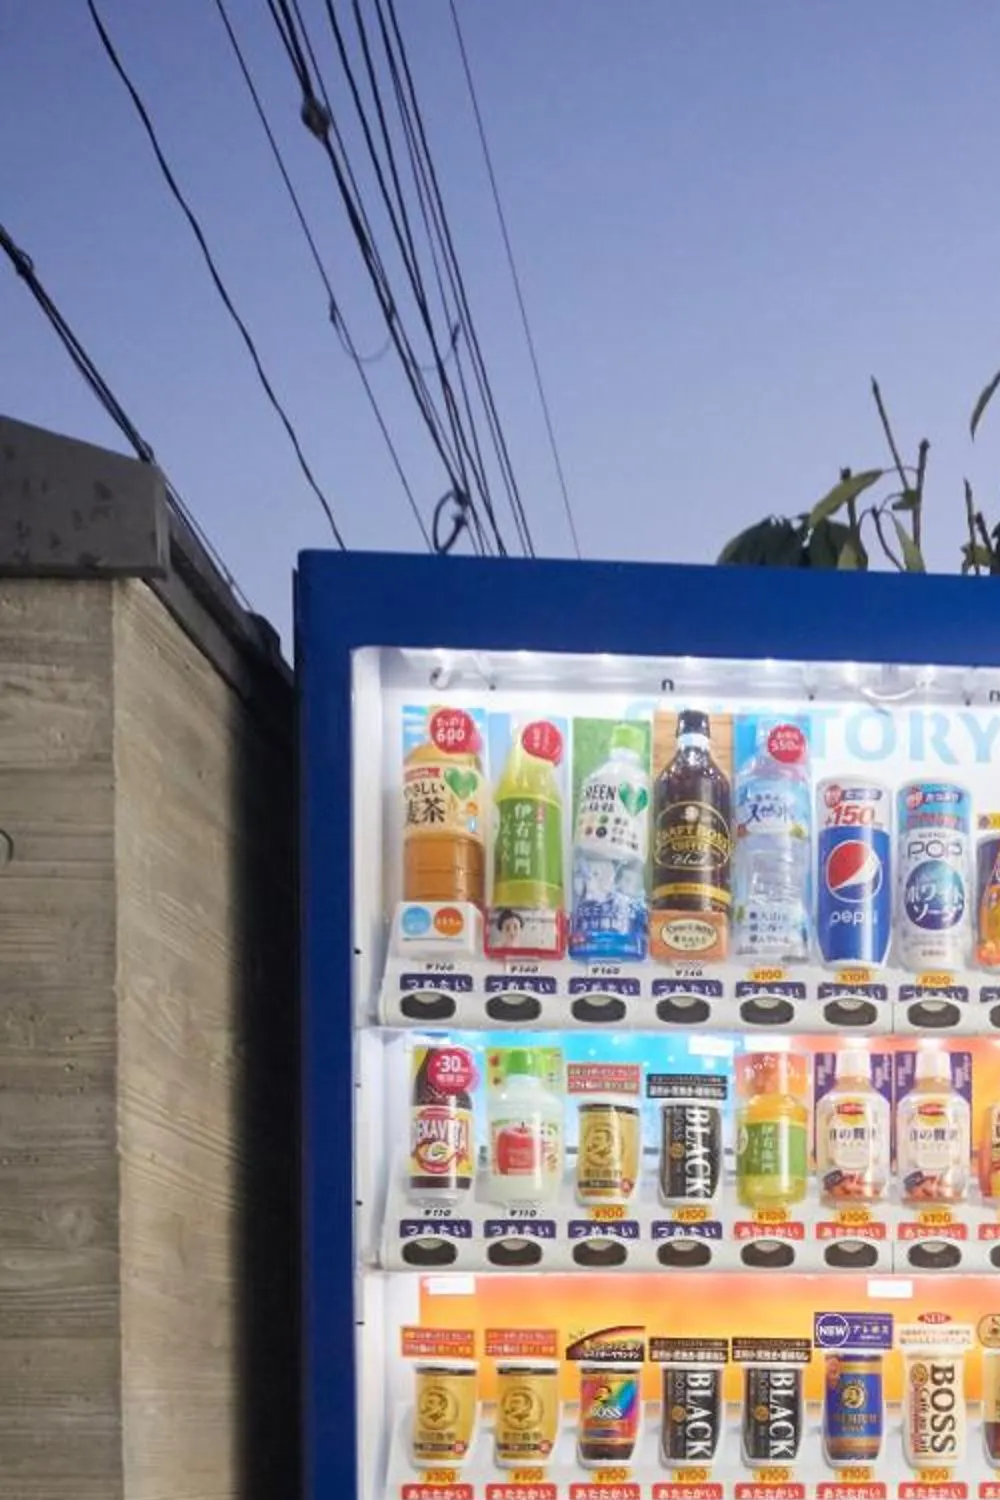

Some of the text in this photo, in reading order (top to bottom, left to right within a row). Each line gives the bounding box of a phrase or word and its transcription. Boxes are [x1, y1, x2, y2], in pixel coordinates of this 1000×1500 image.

[684, 1104, 712, 1200] BLACK
[405, 1224, 466, 1236] つめたい
[490, 1224, 550, 1236] つめたい
[574, 1225, 634, 1237] つめたい
[657, 1226, 717, 1237] つめたい
[819, 1326, 847, 1337] NEW
[768, 1371, 796, 1457] BLACK
[930, 1364, 956, 1453] BOSS
[685, 1371, 713, 1459] BLACK
[407, 1488, 469, 1499] あたたかい
[491, 1488, 553, 1499] あたたかい
[575, 1488, 637, 1499] あたたかい
[658, 1488, 717, 1499] あたたかい
[740, 1488, 800, 1499] あたたかい
[822, 1487, 881, 1498] あたたかい
[903, 1487, 962, 1498] あたたかい
